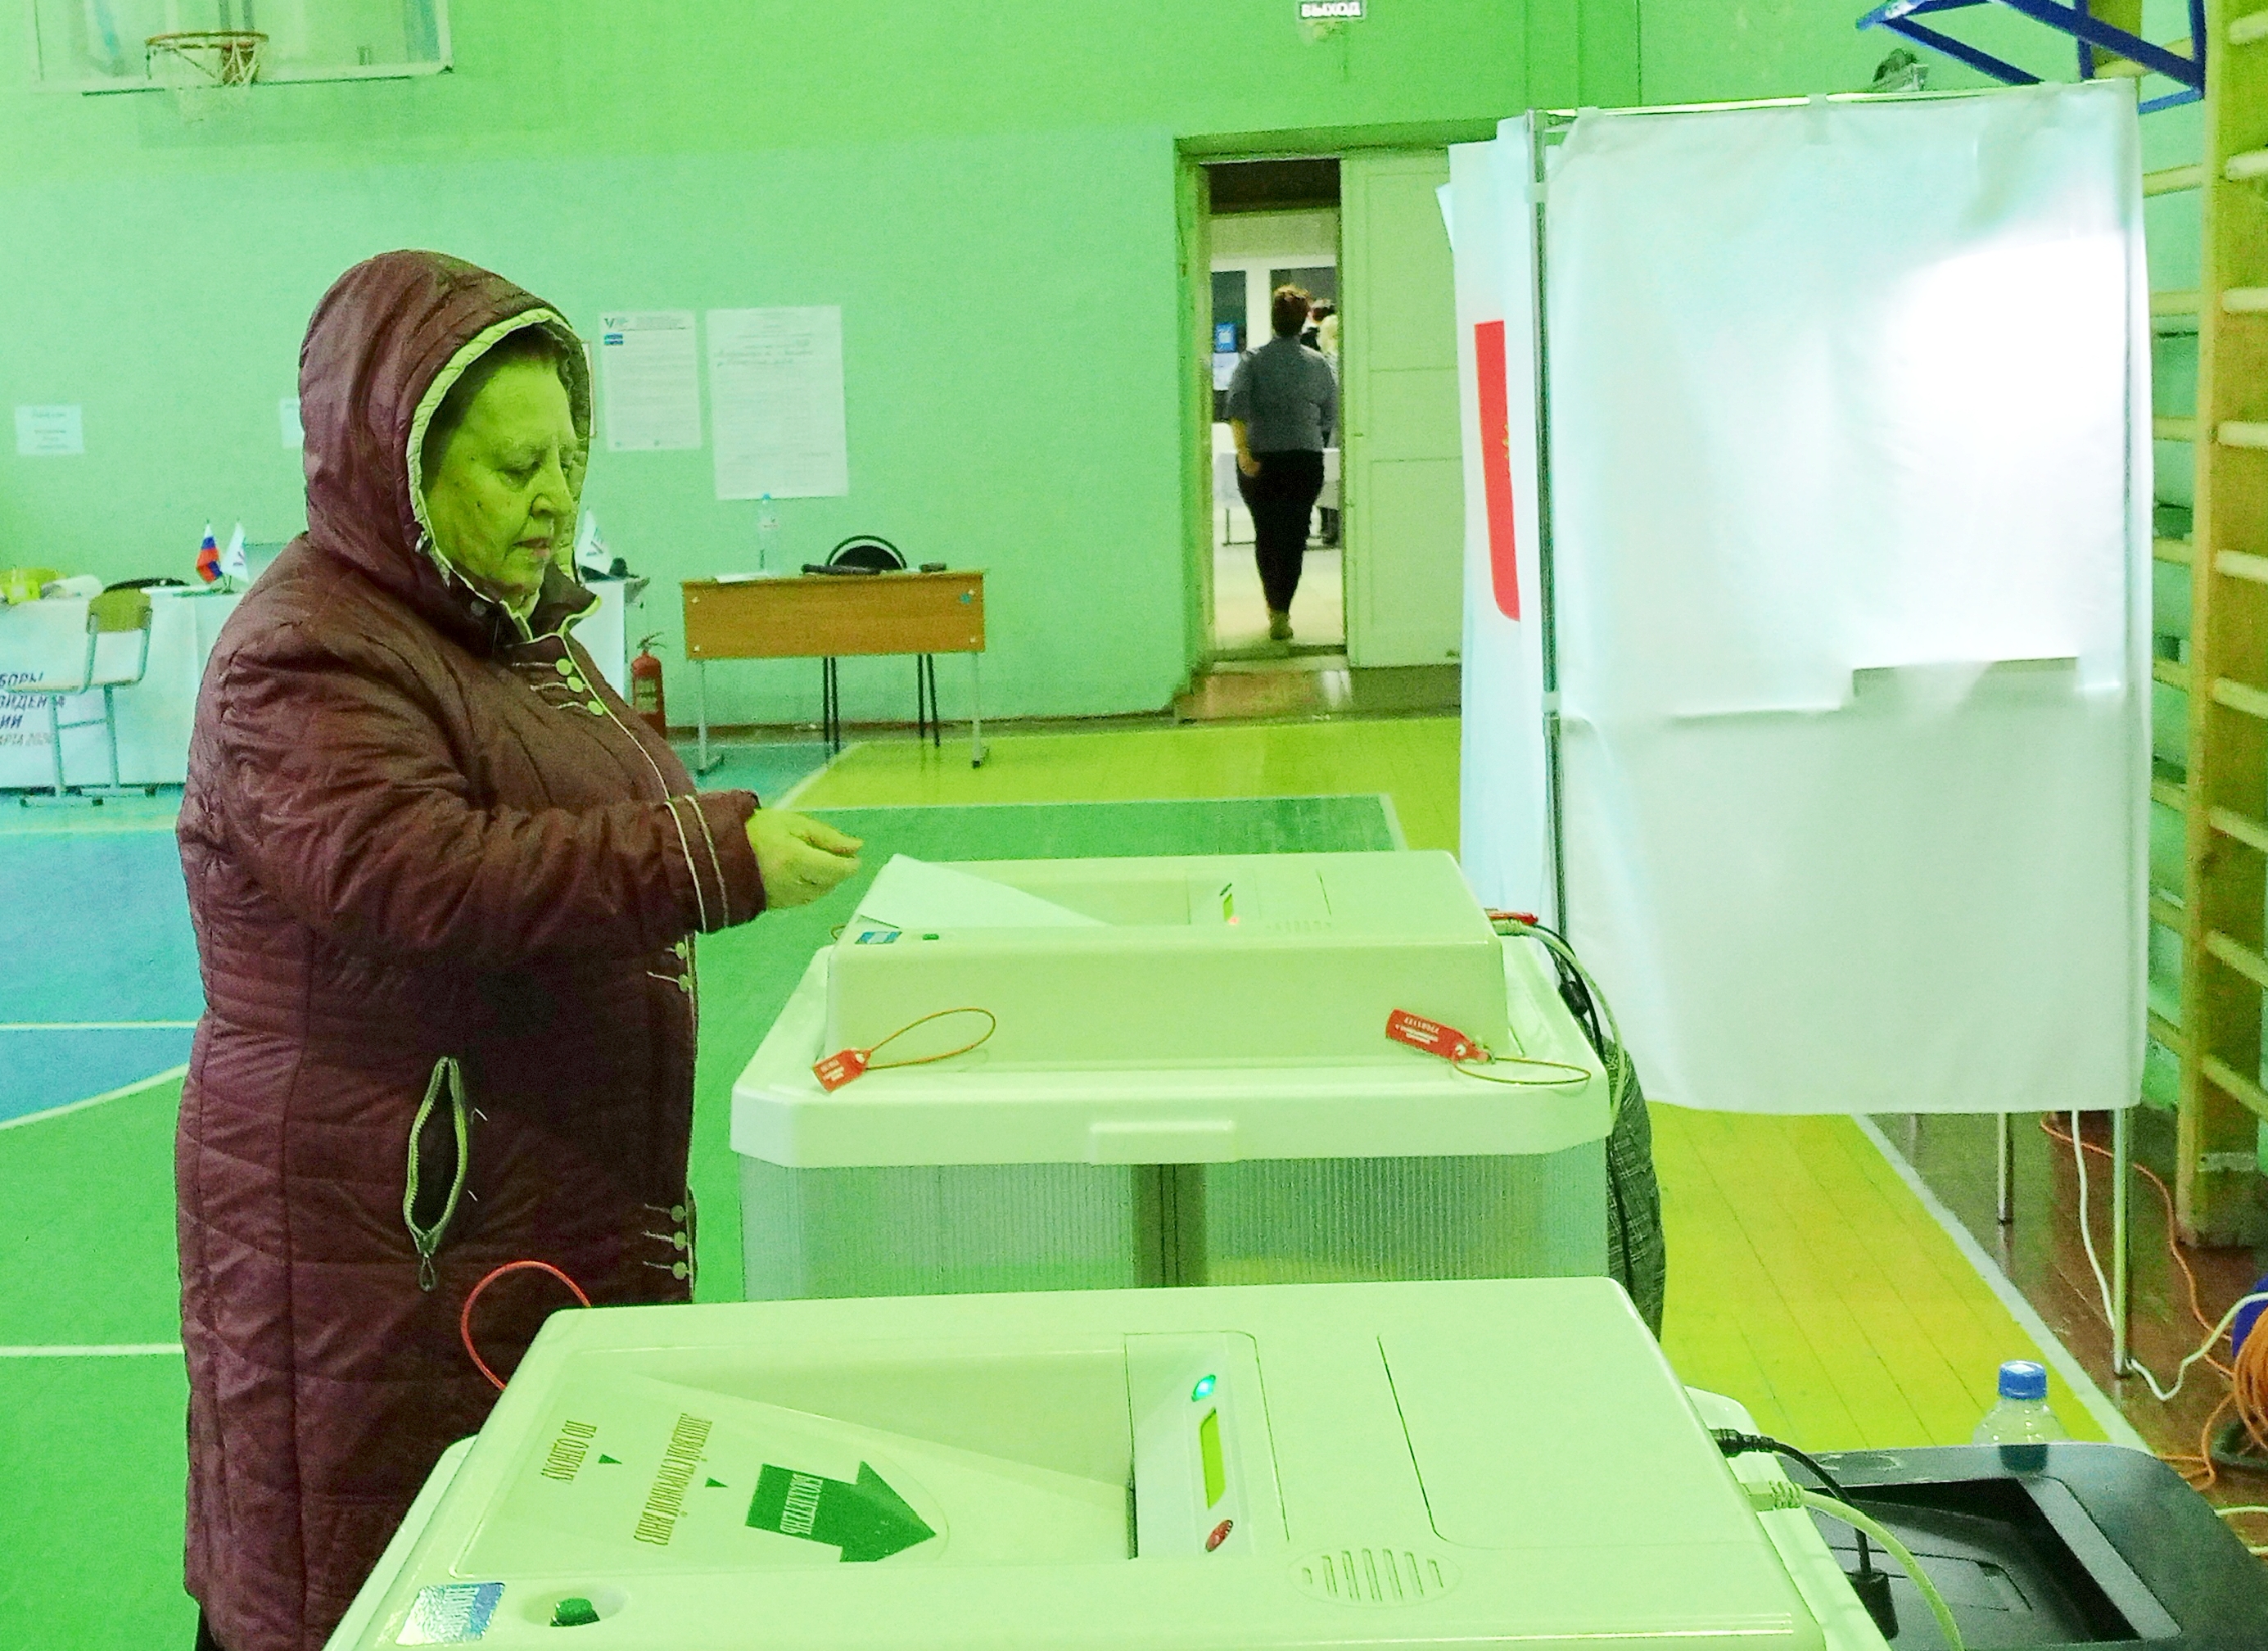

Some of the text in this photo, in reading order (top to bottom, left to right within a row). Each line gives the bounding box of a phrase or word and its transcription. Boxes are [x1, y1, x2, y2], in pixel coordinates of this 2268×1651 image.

[1301, 2, 1361, 16] ВЫХОД
[540, 1420, 597, 1481] ПО ОДНОМУ
